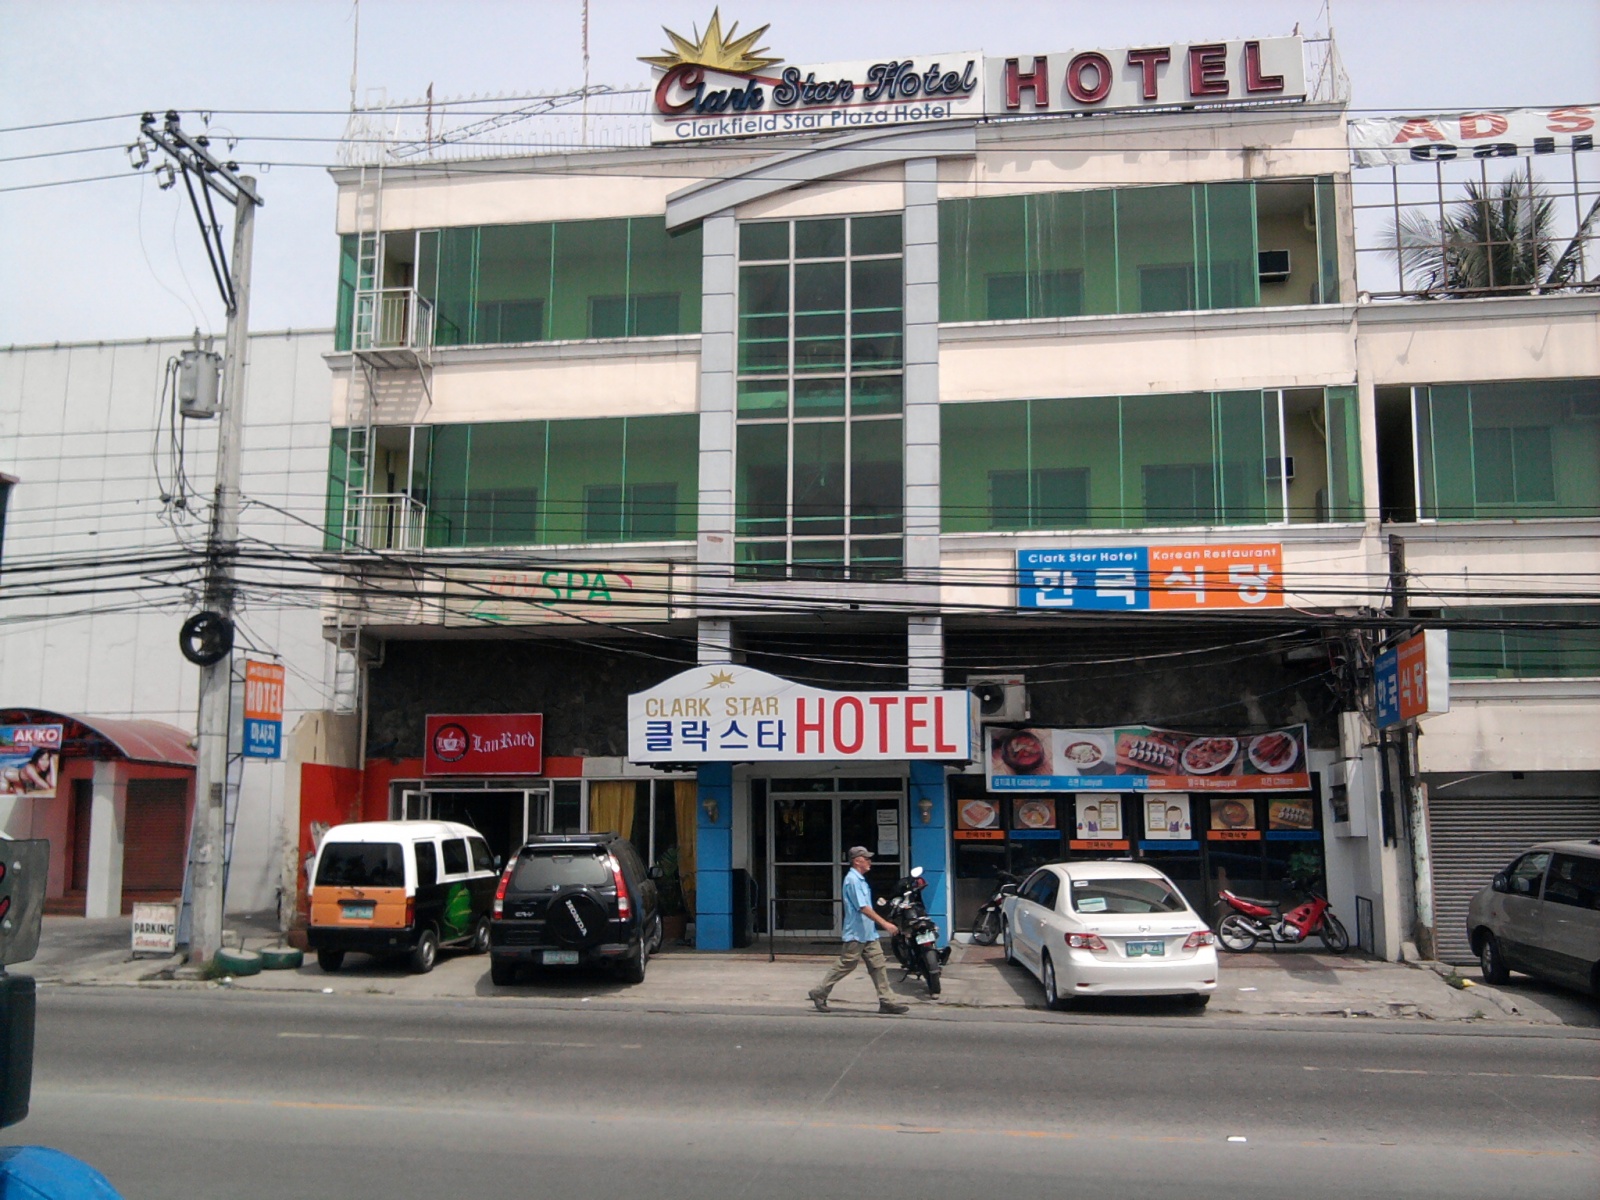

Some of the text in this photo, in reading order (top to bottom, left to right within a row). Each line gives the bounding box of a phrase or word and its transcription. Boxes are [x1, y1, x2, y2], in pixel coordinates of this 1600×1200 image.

[655, 60, 978, 115] Clark Star Hotel
[1005, 41, 1285, 109] HOTEL
[675, 101, 951, 138] Clarkfield Star Plaza Hotel
[1028, 547, 1277, 564] Clark Star Hotel Korean Restaurant
[541, 570, 613, 606] SPA
[246, 680, 282, 714] HOTEL
[645, 696, 780, 718] CLARK STAR
[15, 728, 58, 742] AKIKO
[645, 719, 787, 752] 클락스타
[796, 695, 957, 755] HOTEL
[133, 922, 175, 936] PARKING
[565, 899, 587, 936] HONDA
